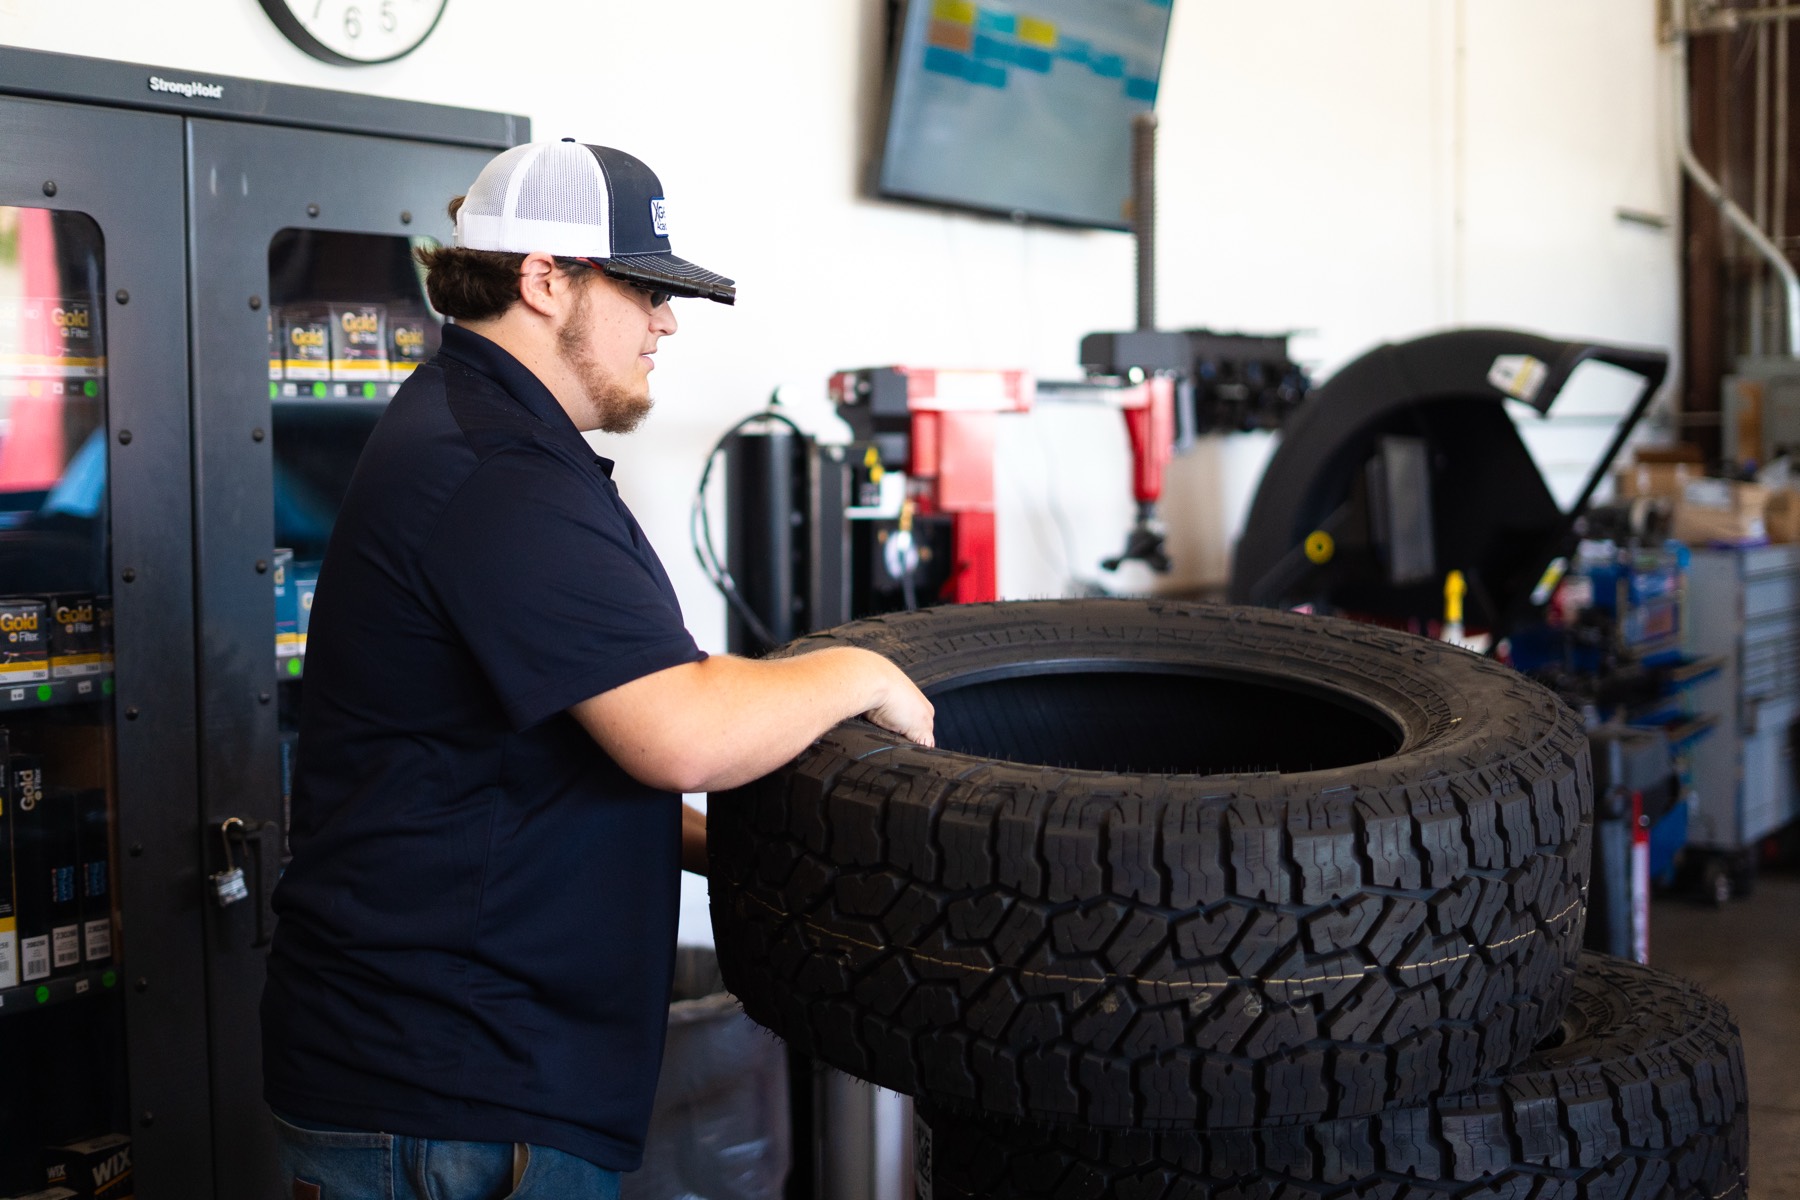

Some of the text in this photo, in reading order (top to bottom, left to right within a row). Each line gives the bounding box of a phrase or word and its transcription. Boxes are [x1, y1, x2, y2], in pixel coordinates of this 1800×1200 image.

[343, 5, 362, 40] 6
[149, 76, 223, 99] StrongHold
[51, 308, 89, 326] Gold
[341, 311, 378, 333] Gold
[291, 327, 325, 346] Gold
[0, 612, 38, 632] Gold
[56, 604, 94, 624] Gold
[19, 769, 36, 811] Gold
[46, 1163, 66, 1178] WIX
[91, 1145, 133, 1186] WIX
